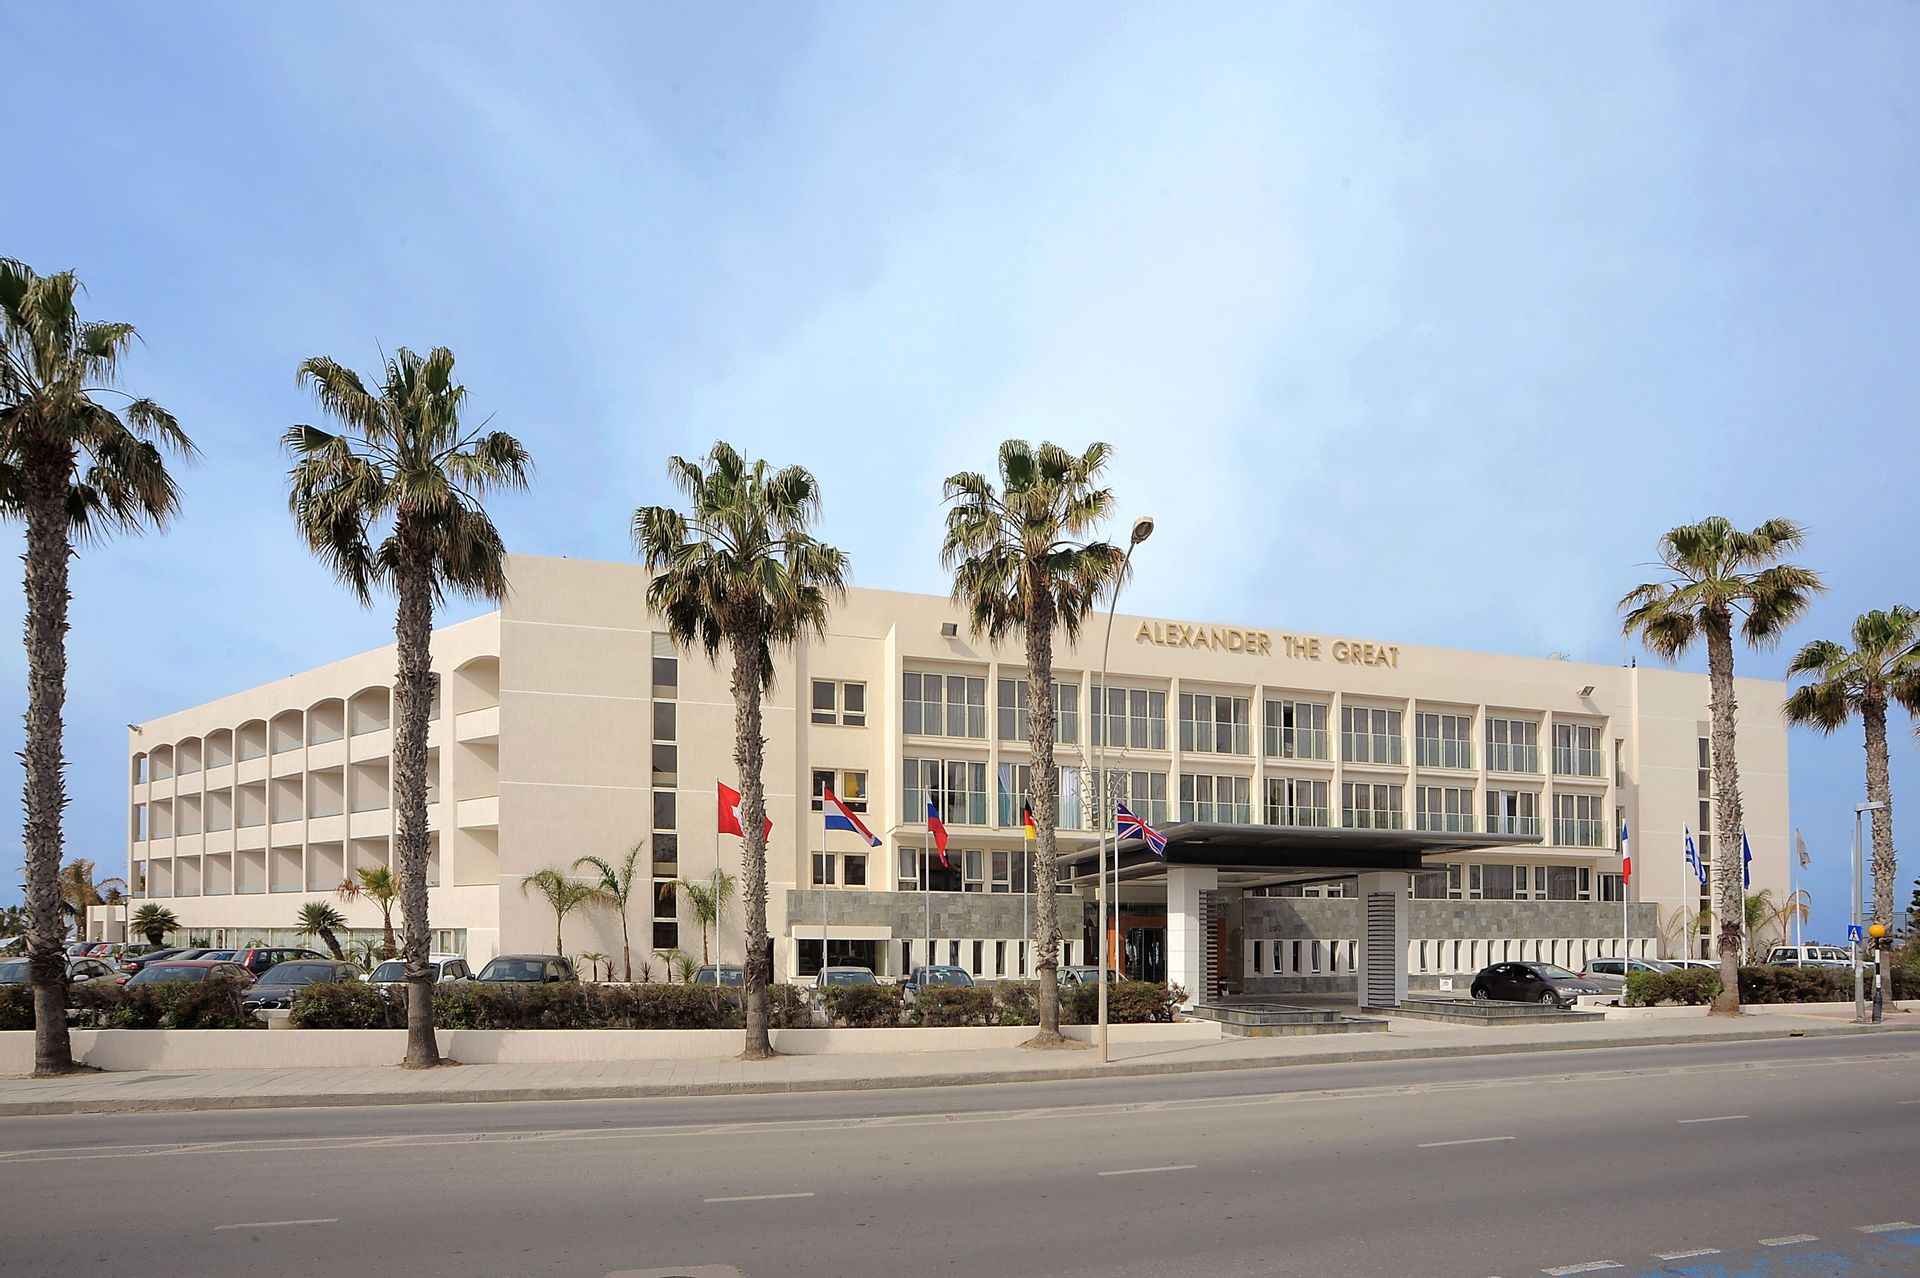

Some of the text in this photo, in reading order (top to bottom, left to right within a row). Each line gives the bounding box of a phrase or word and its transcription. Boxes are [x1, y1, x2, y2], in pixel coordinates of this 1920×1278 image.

[1136, 621, 1399, 669] ALEXANDER THE GREAT
